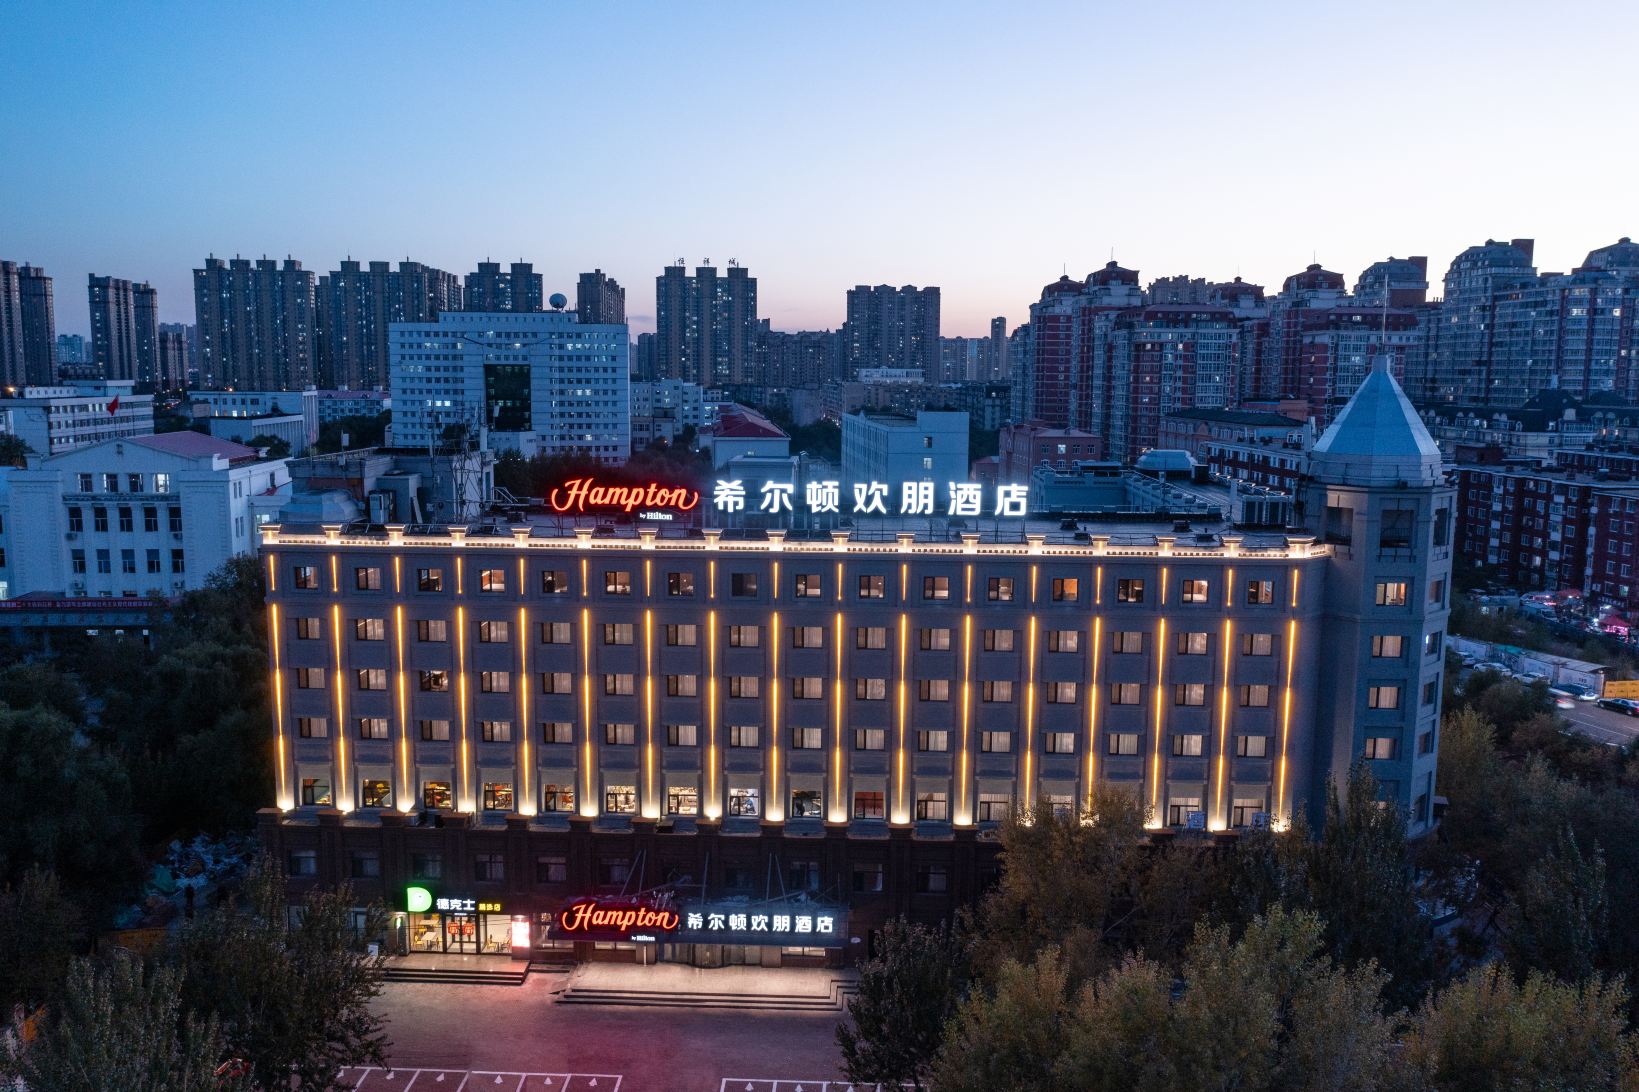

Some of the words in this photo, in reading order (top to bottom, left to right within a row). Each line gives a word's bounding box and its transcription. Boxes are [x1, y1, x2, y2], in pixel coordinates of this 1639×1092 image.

[551, 477, 699, 512] Hampton
[713, 479, 1029, 516] 希尔顿欢朋酒店
[647, 511, 673, 520] Hilton
[436, 898, 476, 911] 德克士
[562, 903, 679, 931] Hampton
[687, 912, 834, 933] 希尔顿欢朋酒店
